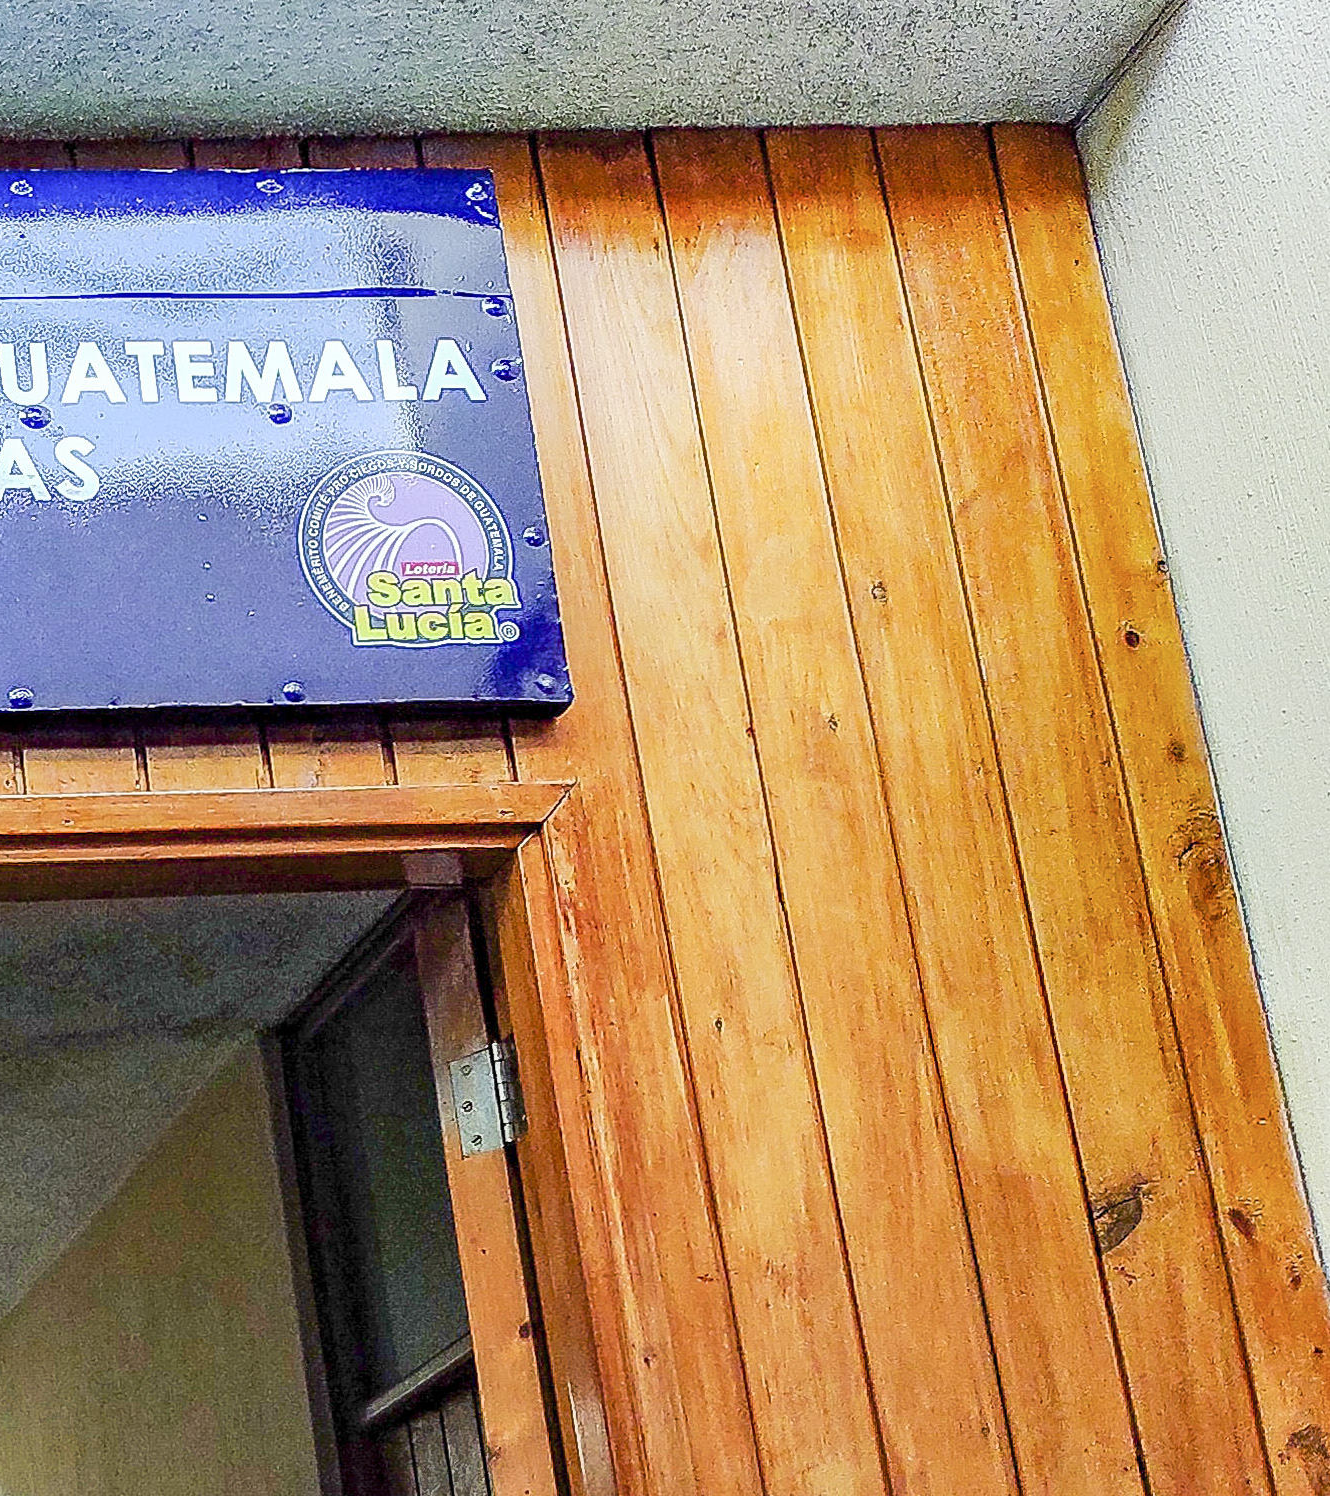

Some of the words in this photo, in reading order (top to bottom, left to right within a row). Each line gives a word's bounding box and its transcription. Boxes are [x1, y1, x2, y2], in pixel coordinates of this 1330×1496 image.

[329, 476, 350, 498] PRO
[408, 459, 460, 487] SORDOS
[459, 484, 476, 503] DE
[474, 501, 505, 571] GUATEMALA
[366, 568, 516, 608] Santa
[354, 603, 497, 641] Lucía
